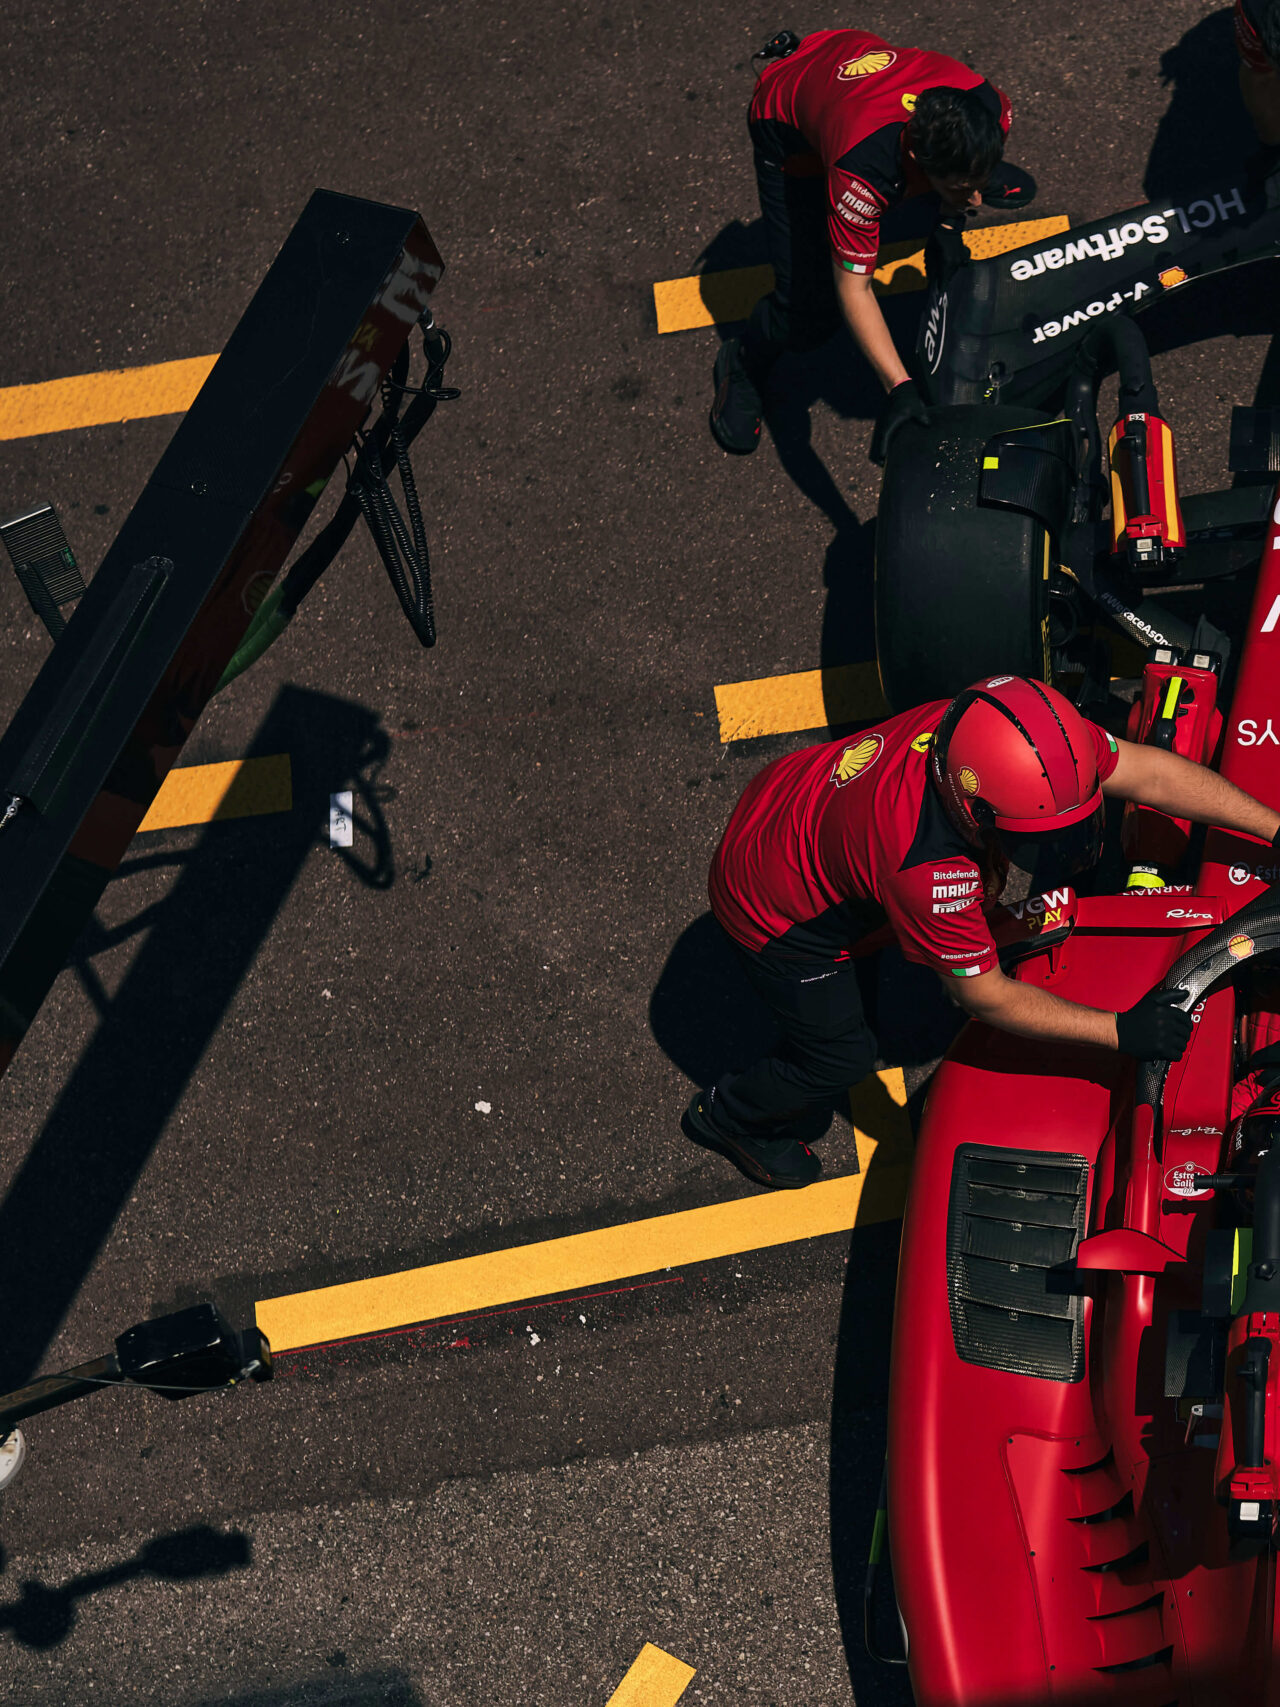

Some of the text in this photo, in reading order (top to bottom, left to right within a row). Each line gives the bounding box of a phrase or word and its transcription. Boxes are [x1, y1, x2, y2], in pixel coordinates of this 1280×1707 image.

[1009, 187, 1247, 281] HCLSoftware
[1032, 282, 1149, 344] V-Power
[933, 869, 979, 880] Bitdefende
[1006, 887, 1069, 920] VGW
[1166, 909, 1214, 919] Riva
[1026, 907, 1062, 930] PLAY
[1173, 1179, 1195, 1188] Gali
